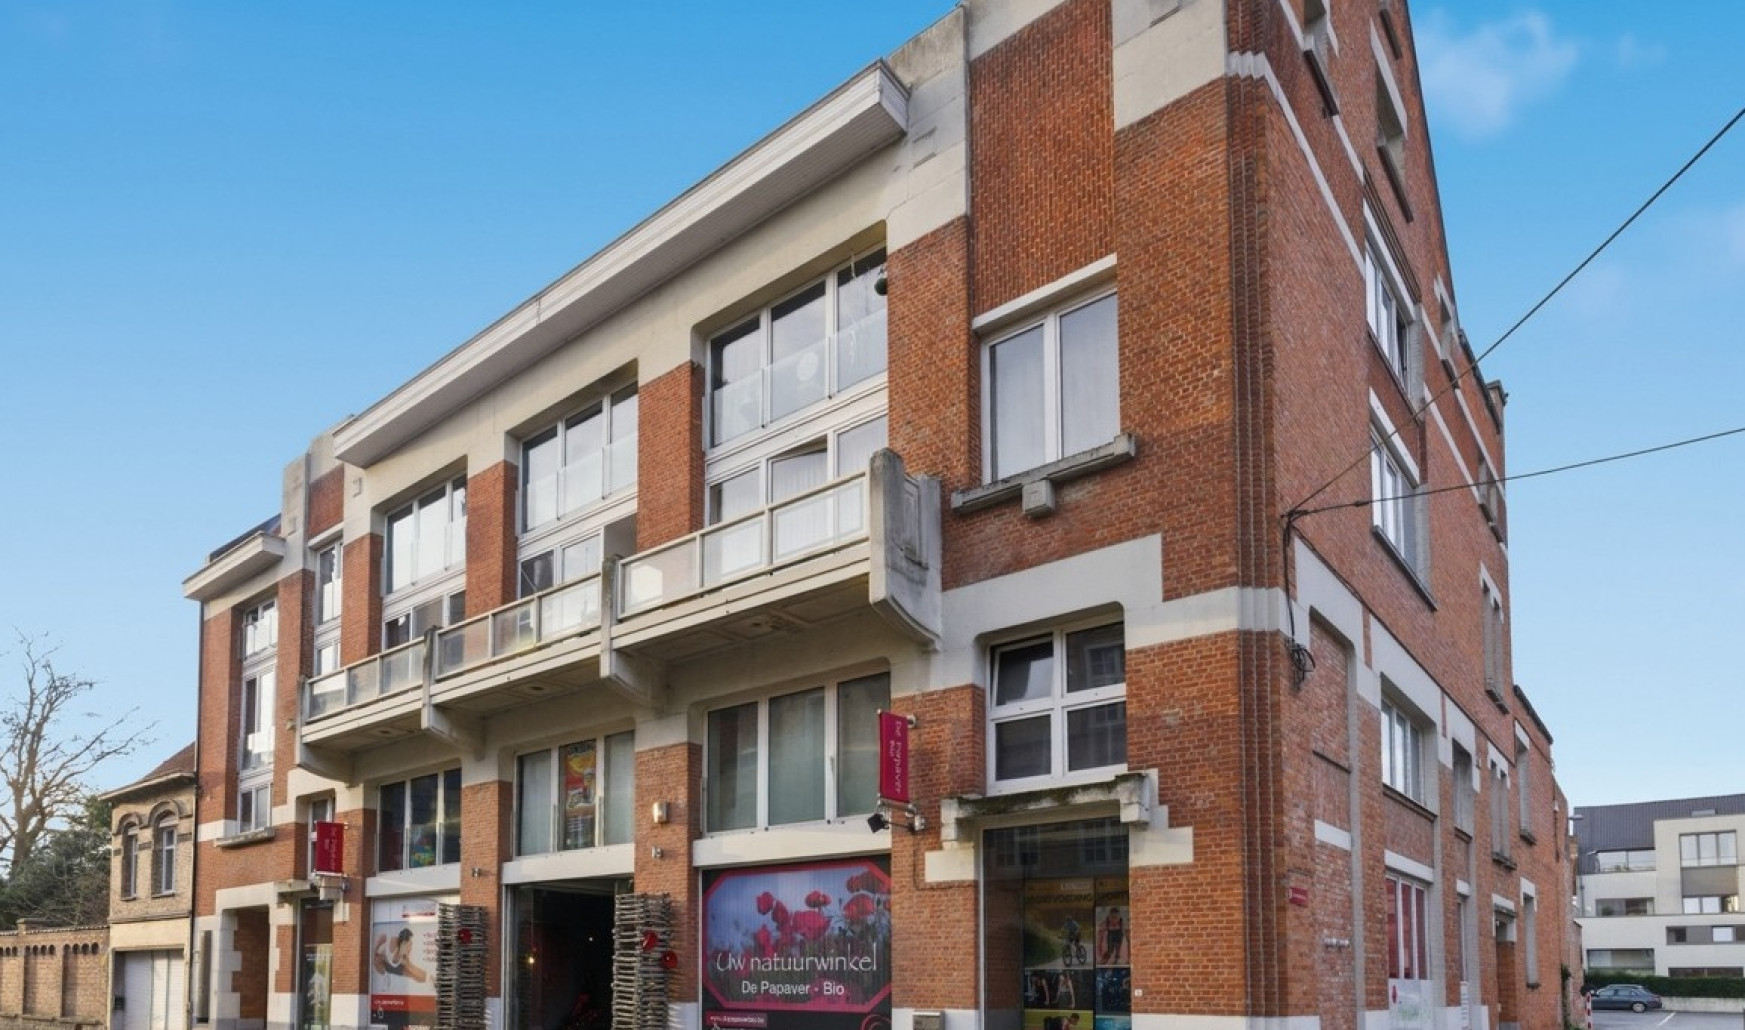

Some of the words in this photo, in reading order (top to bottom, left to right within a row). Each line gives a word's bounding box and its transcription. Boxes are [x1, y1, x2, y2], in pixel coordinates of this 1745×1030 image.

[716, 952, 746, 971] Uw
[750, 941, 877, 971] natuurwinkel
[742, 980, 757, 993] De
[761, 981, 810, 996] Papaver
[823, 981, 844, 996] Bio
